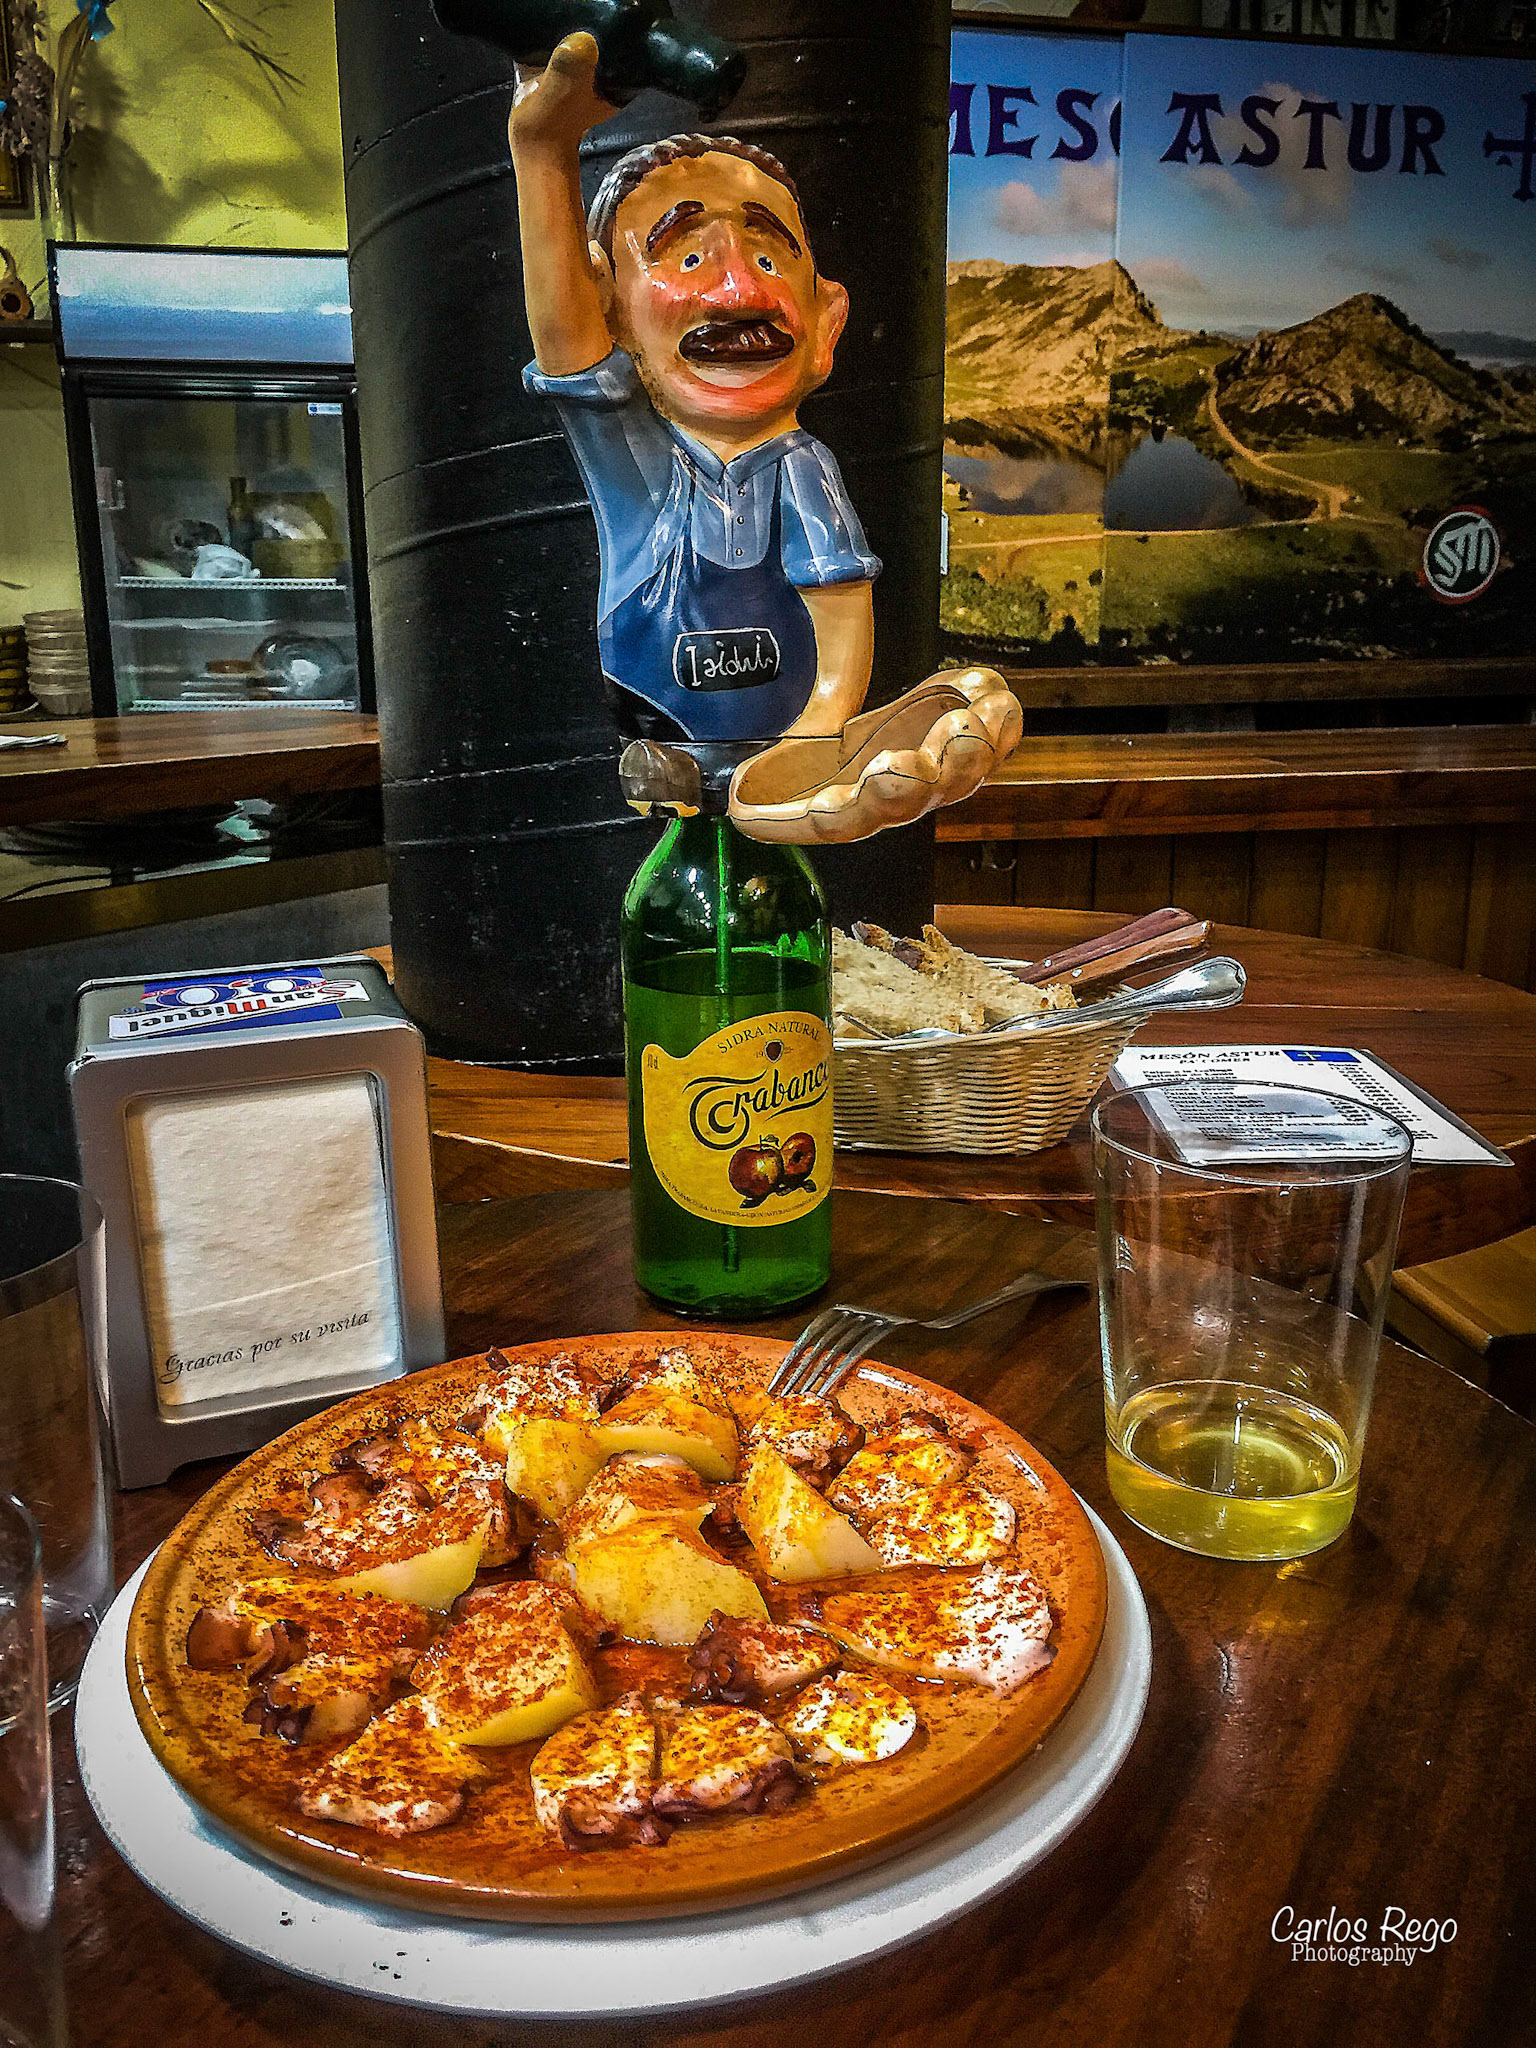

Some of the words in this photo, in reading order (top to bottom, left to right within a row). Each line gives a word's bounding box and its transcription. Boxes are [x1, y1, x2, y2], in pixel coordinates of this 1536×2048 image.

[950, 82, 1121, 162] ES
[1159, 91, 1446, 175] ASTUR
[272, 984, 355, 1003] San
[128, 999, 277, 1032] Miguel
[718, 1026, 764, 1054] SIDRA
[768, 1021, 820, 1040] NATURAL
[1140, 1051, 1210, 1060] MESÓN
[1216, 1050, 1280, 1058] ASTUR
[160, 1347, 243, 1385] Gracias
[251, 1337, 282, 1363] por
[291, 1327, 311, 1344] su
[317, 1311, 370, 1338] visita
